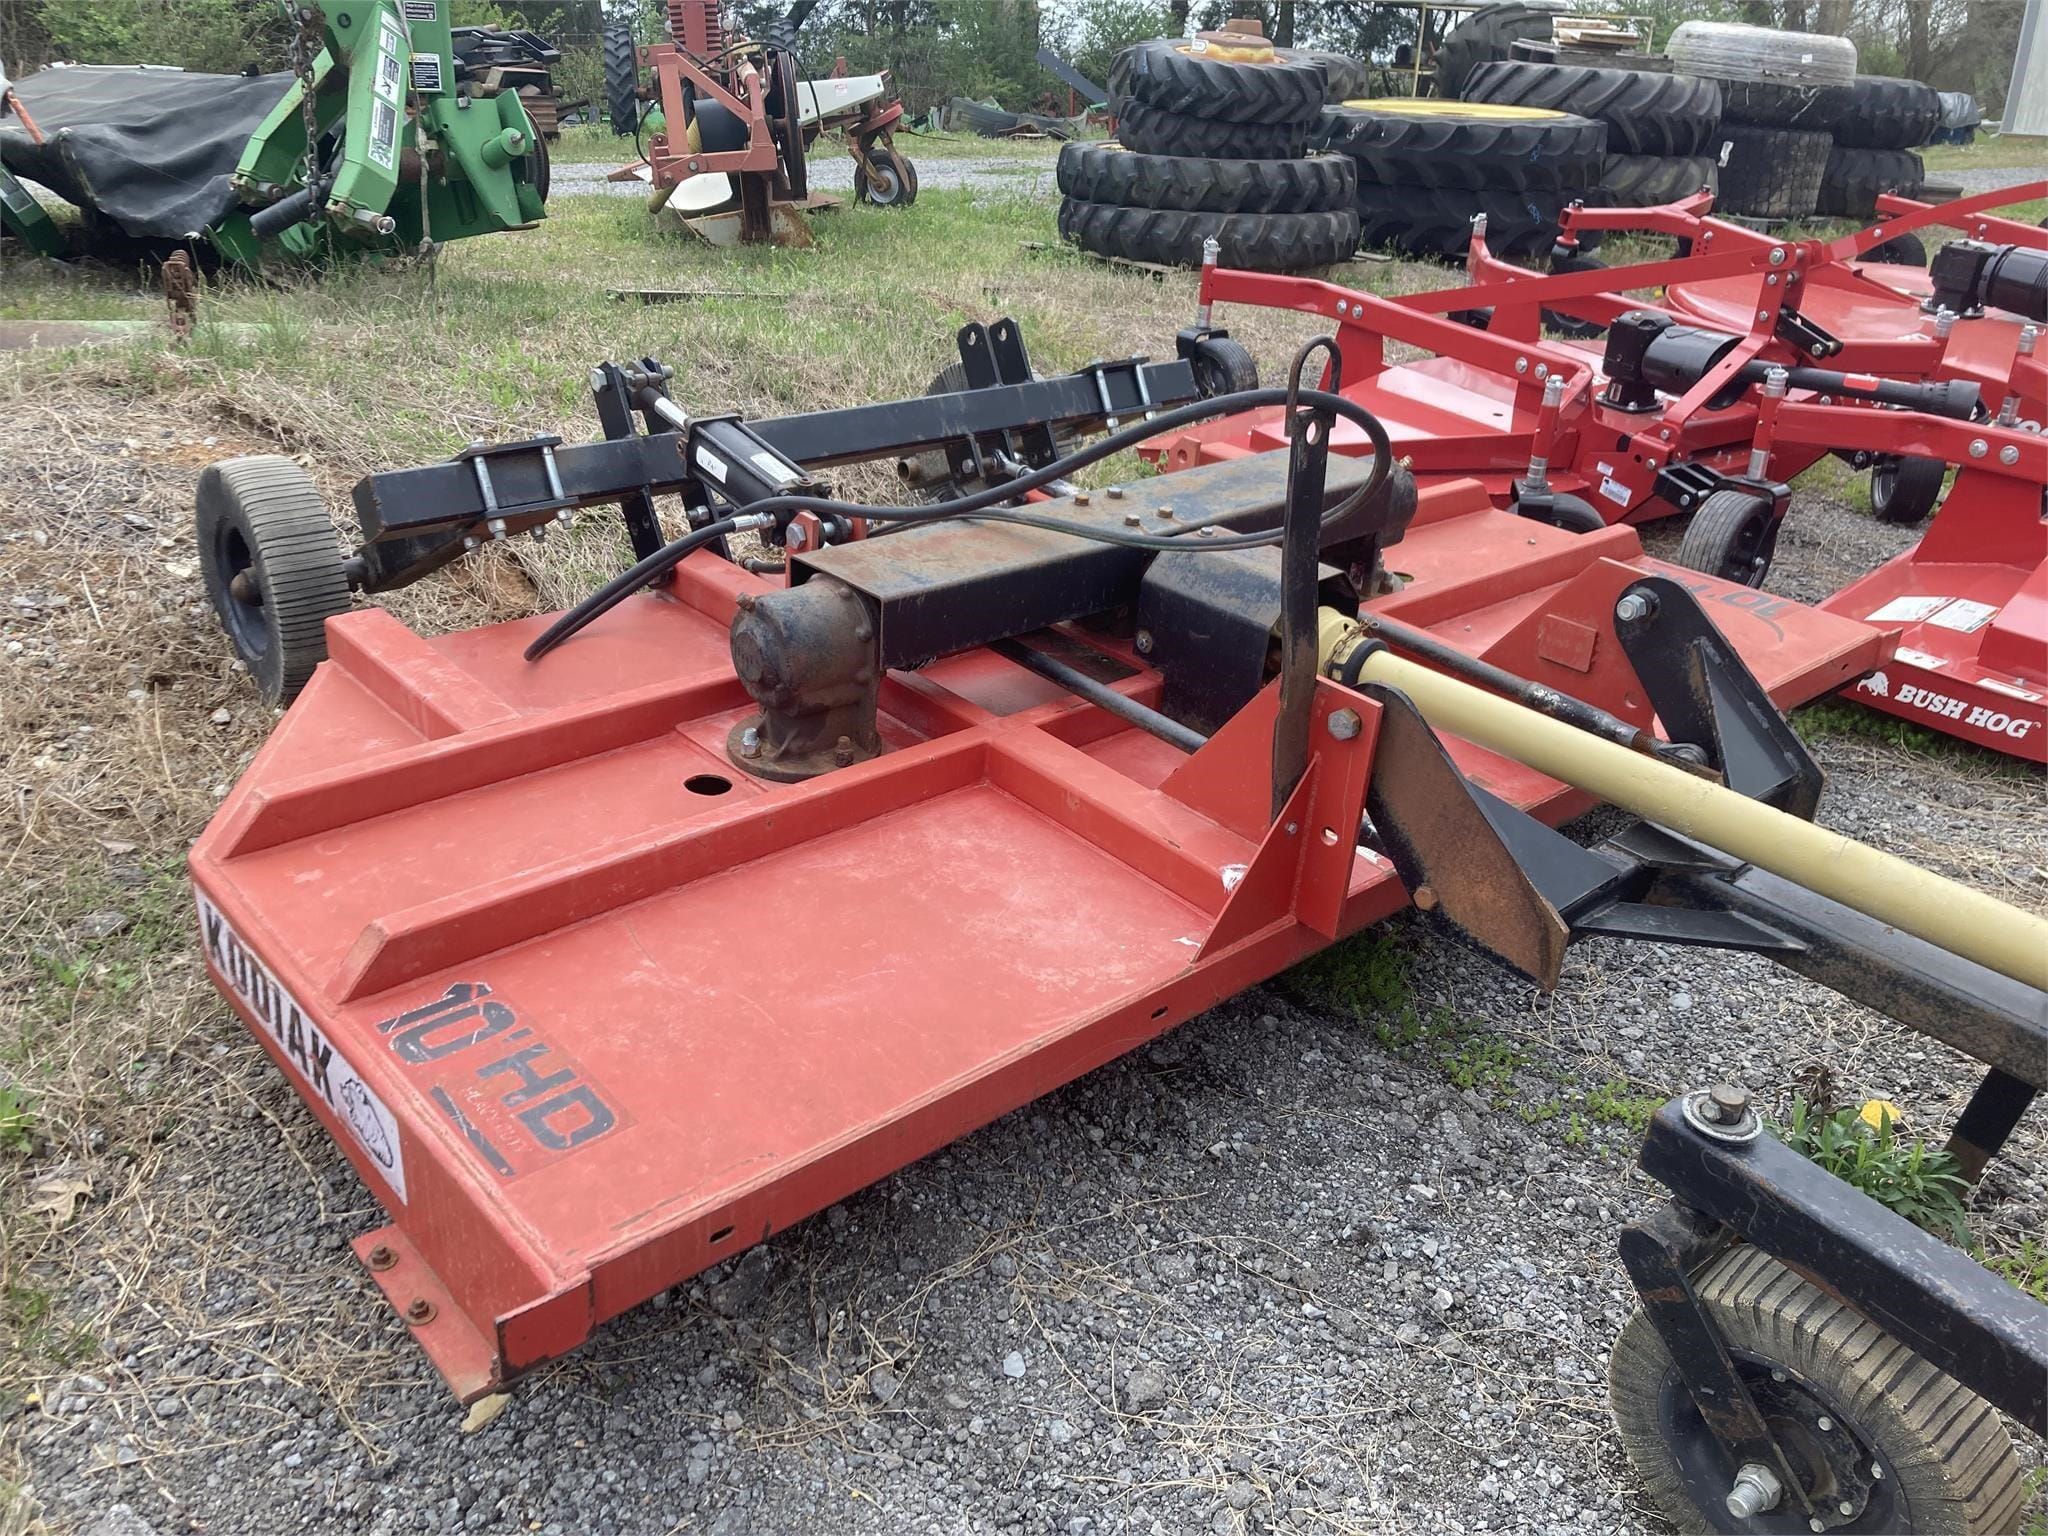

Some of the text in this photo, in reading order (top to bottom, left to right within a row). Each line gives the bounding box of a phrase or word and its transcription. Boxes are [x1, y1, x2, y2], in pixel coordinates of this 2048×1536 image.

[1894, 683, 1969, 719] BUSH
[1966, 706, 2033, 739] HOG
[204, 902, 335, 1108] KODIAK
